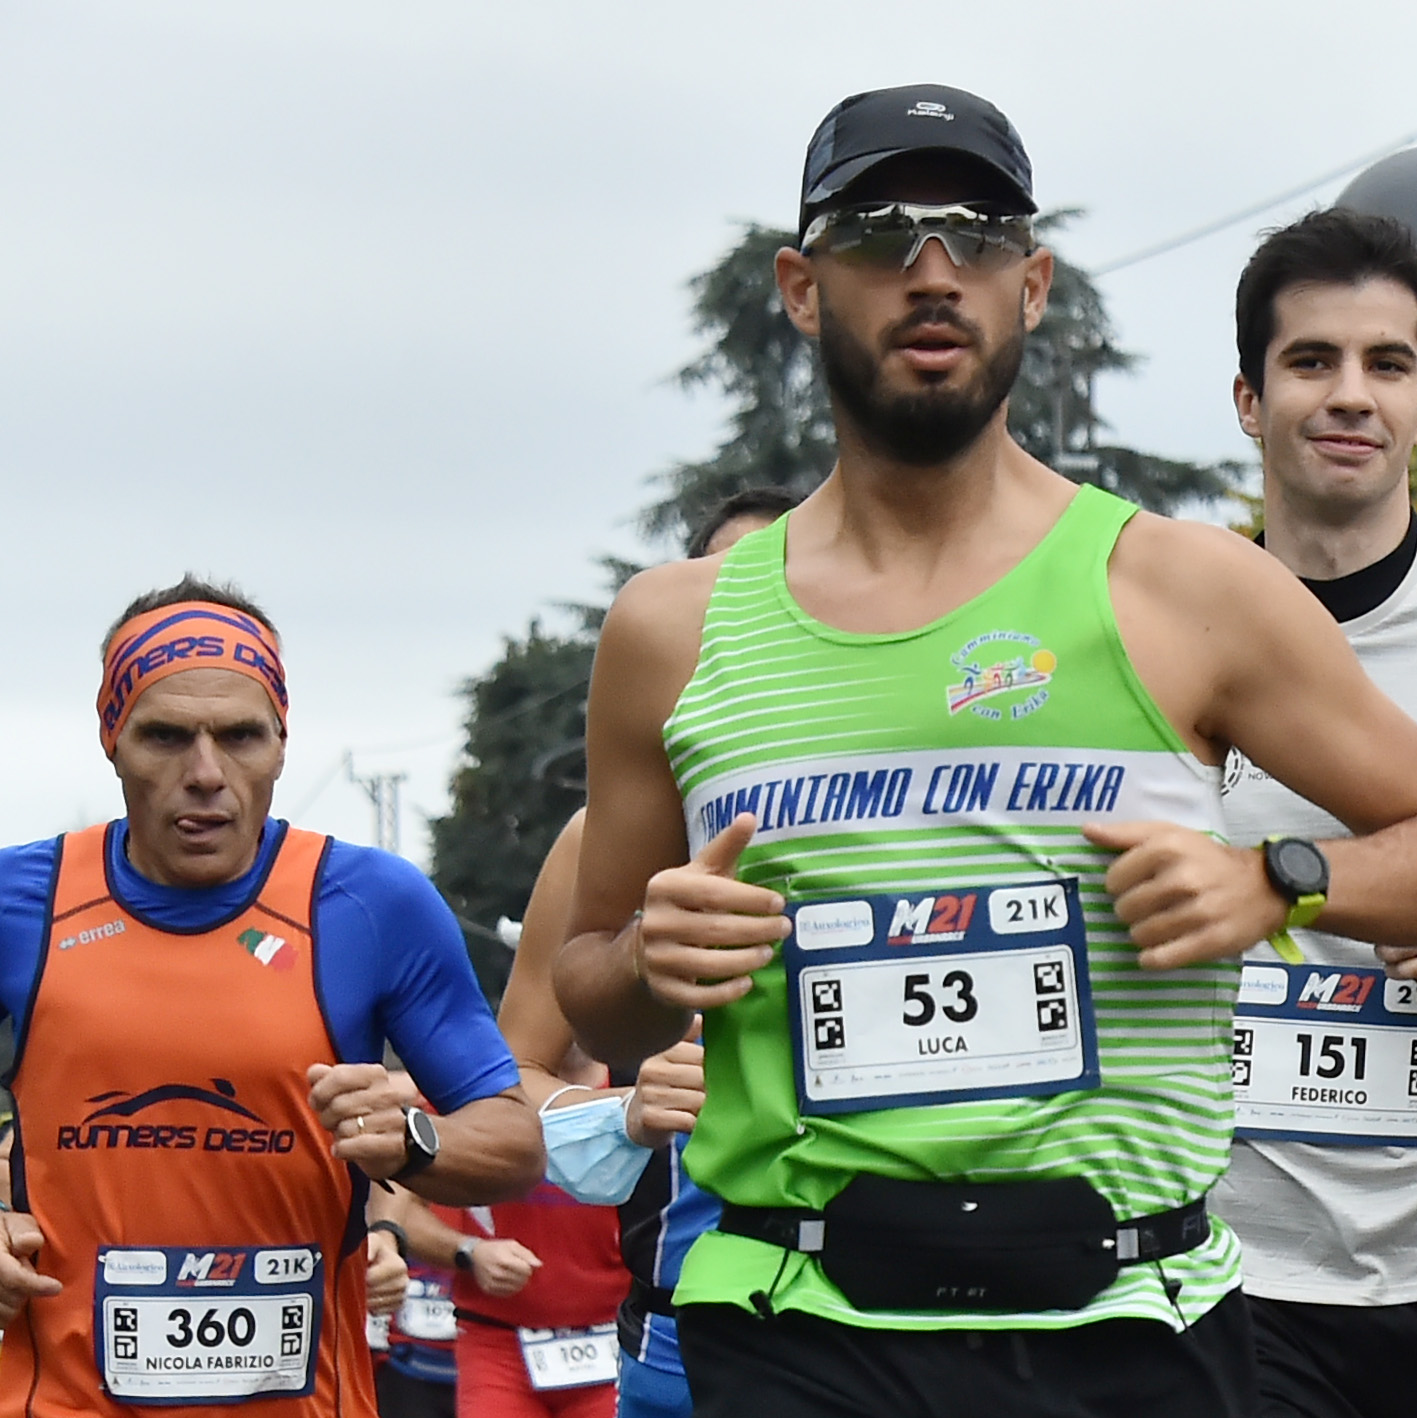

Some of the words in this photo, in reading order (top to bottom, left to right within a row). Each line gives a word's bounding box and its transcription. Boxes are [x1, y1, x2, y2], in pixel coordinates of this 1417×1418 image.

[922, 763, 1000, 814] CON
[1006, 762, 1126, 813] ERIKA
[889, 893, 977, 937] M21
[1006, 895, 1061, 922] 21K
[902, 970, 979, 1026] 53
[1299, 972, 1376, 1005] M21
[918, 1036, 968, 1055] LUCA
[1296, 1033, 1367, 1080] 151
[1291, 1086, 1368, 1105] FEDERICO
[177, 1252, 247, 1281] M21
[267, 1256, 308, 1275] 21K
[165, 1307, 256, 1348] 360
[146, 1356, 202, 1370] NICOLA
[207, 1354, 274, 1369] FABRIZIO
[560, 1343, 597, 1363] 100
